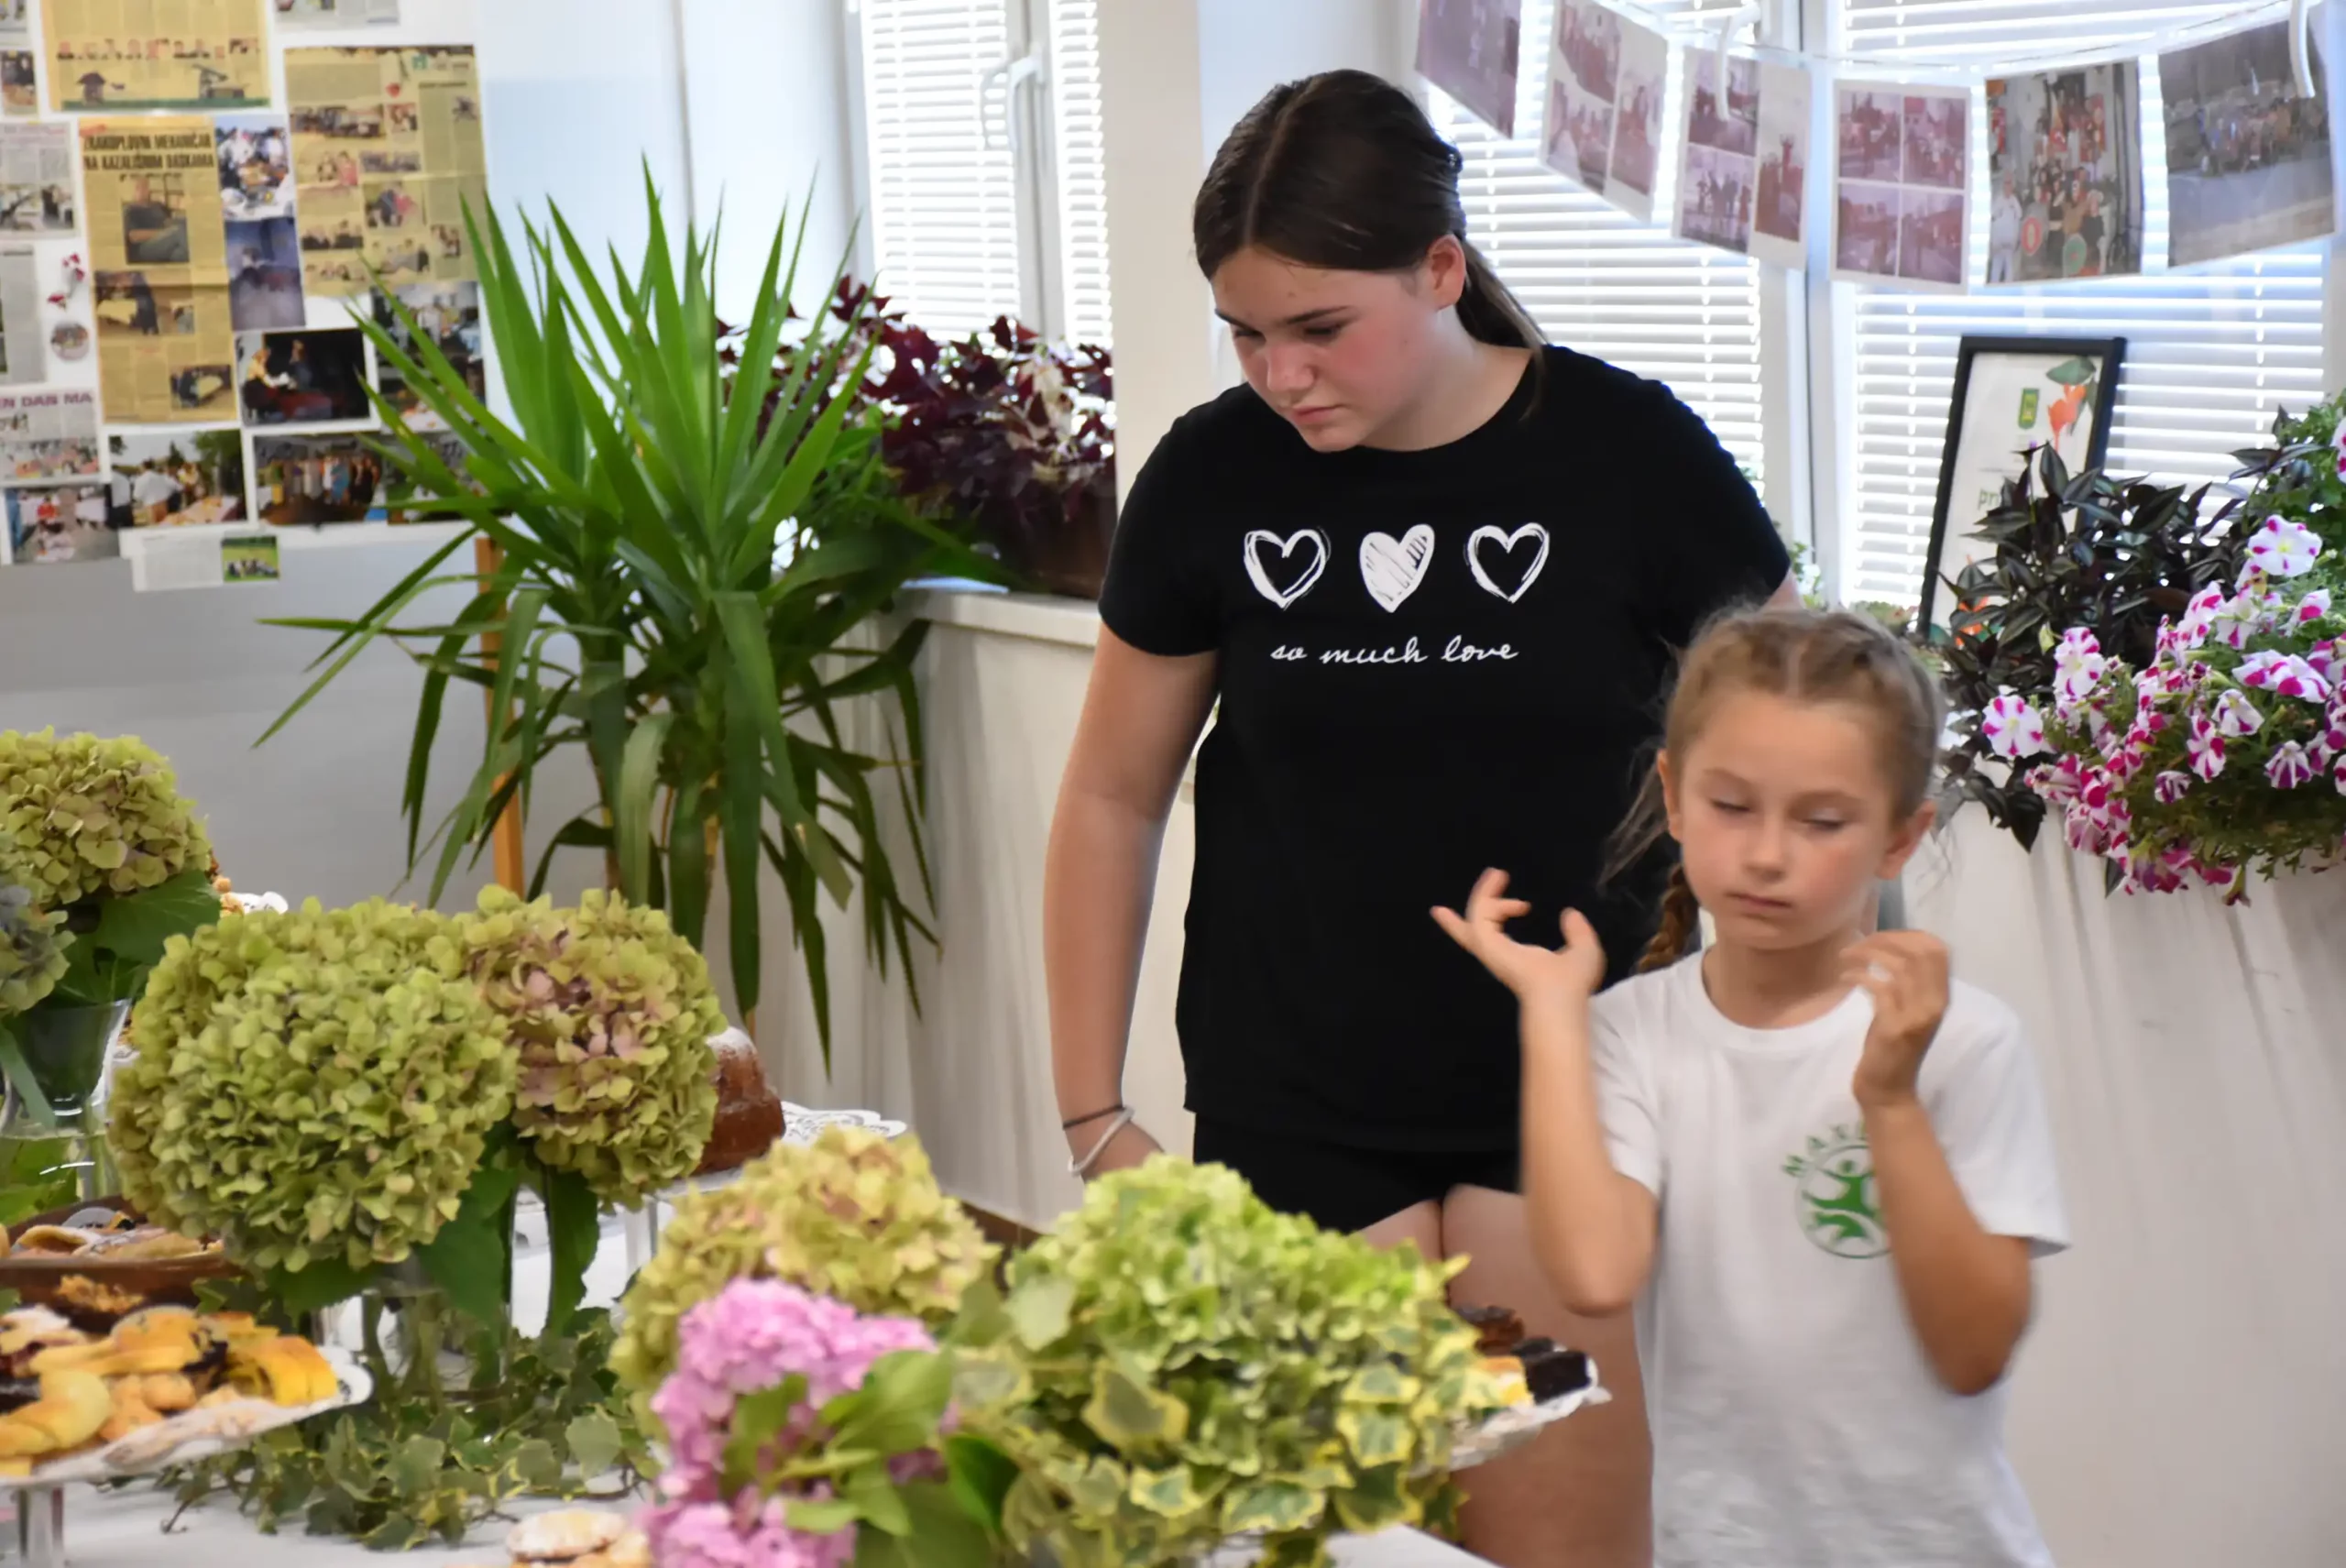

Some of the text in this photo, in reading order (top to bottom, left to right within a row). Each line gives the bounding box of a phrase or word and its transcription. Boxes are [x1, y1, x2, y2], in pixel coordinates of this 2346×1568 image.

[1270, 634, 1519, 664] so much love
